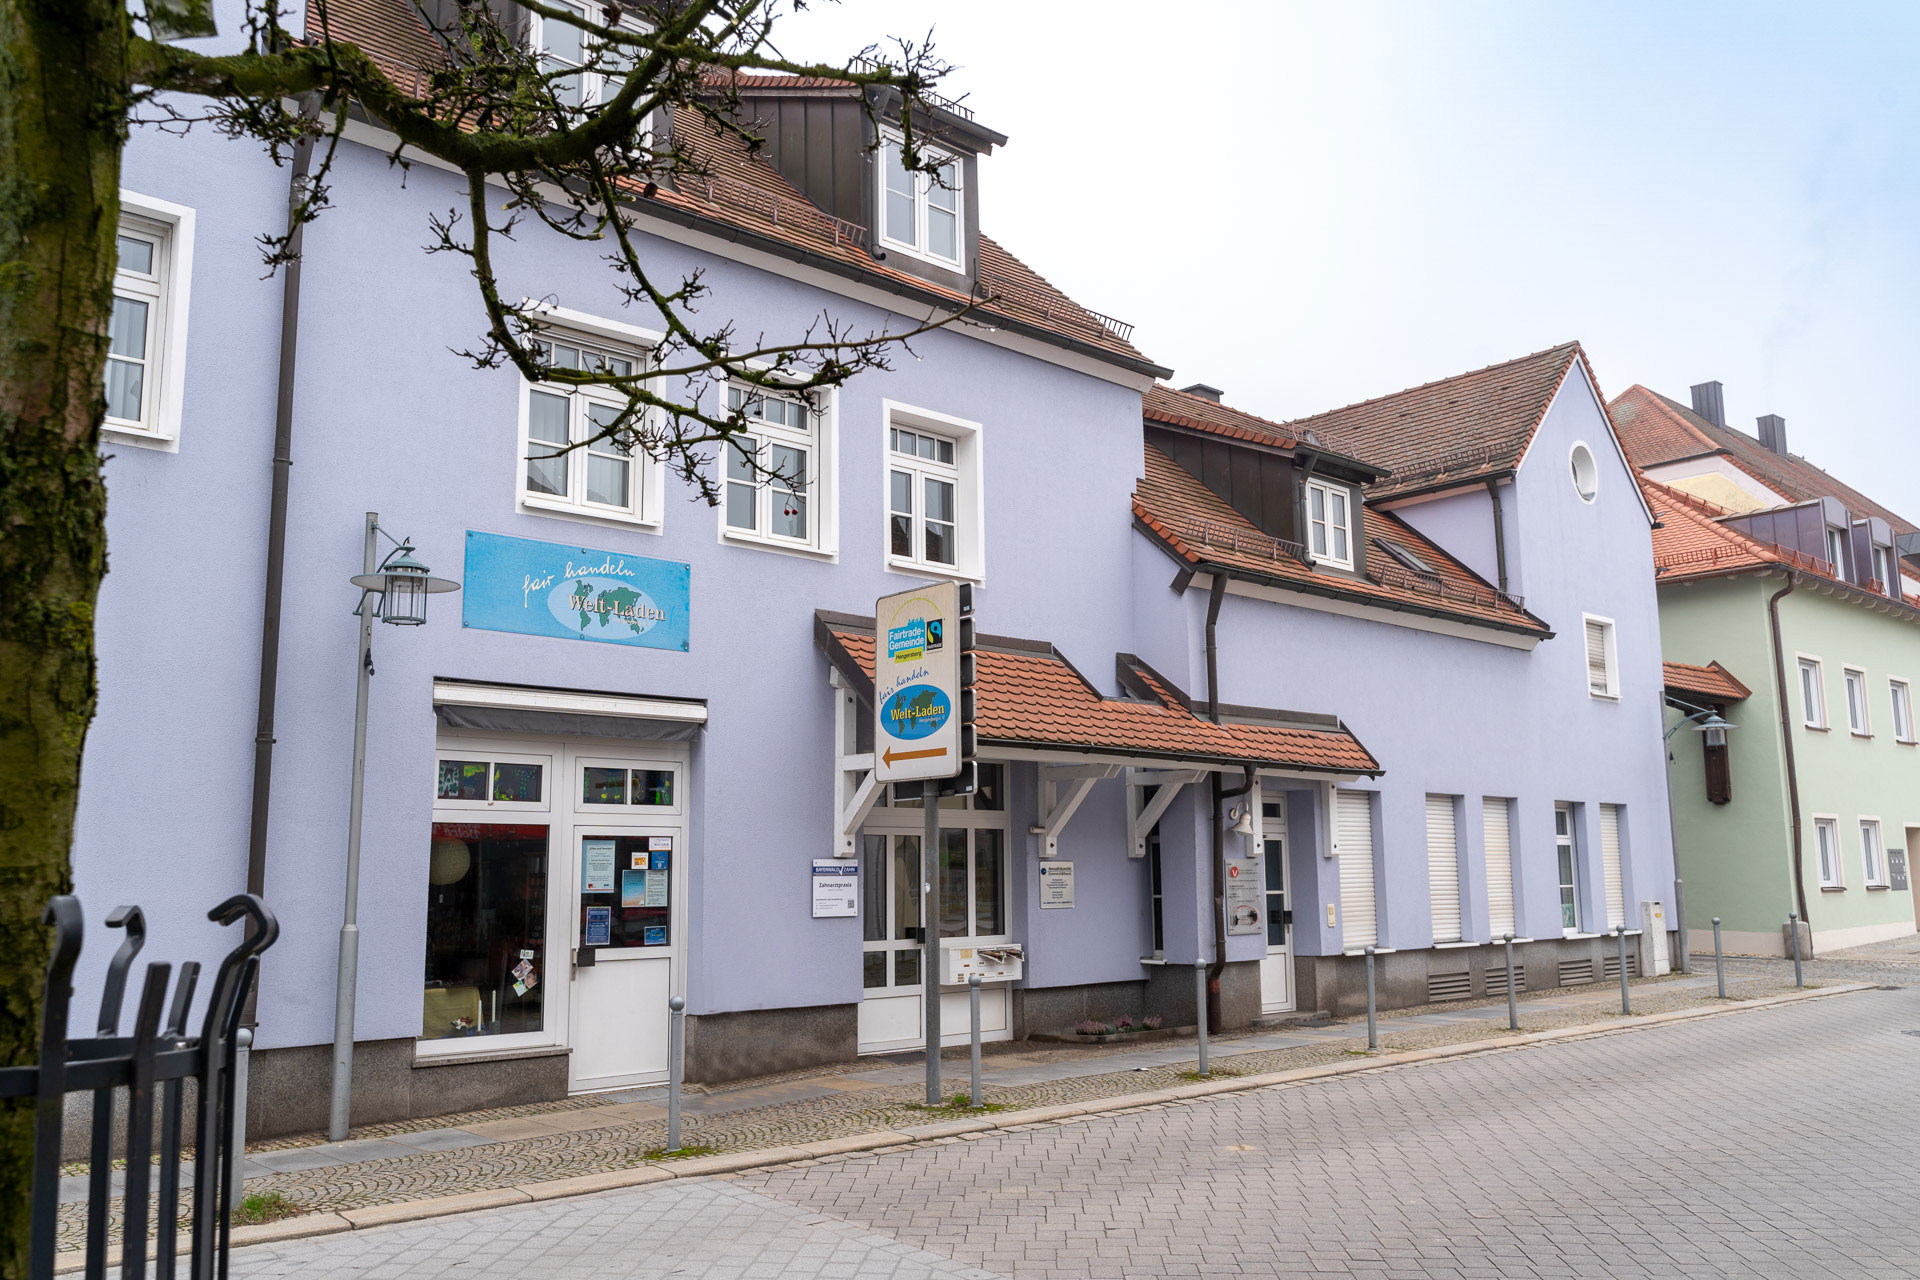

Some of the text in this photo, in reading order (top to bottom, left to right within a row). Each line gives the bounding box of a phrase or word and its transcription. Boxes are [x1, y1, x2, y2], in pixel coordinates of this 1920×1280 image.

[522, 555, 635, 608] fair handeln
[568, 594, 666, 621] Welt-Laden
[889, 627, 924, 641] Fairtrade-
[889, 636, 924, 650] Gemeinde
[895, 651, 922, 660] Hengersberg
[879, 667, 929, 705] fair handeln
[890, 704, 945, 721] Welt-Laden
